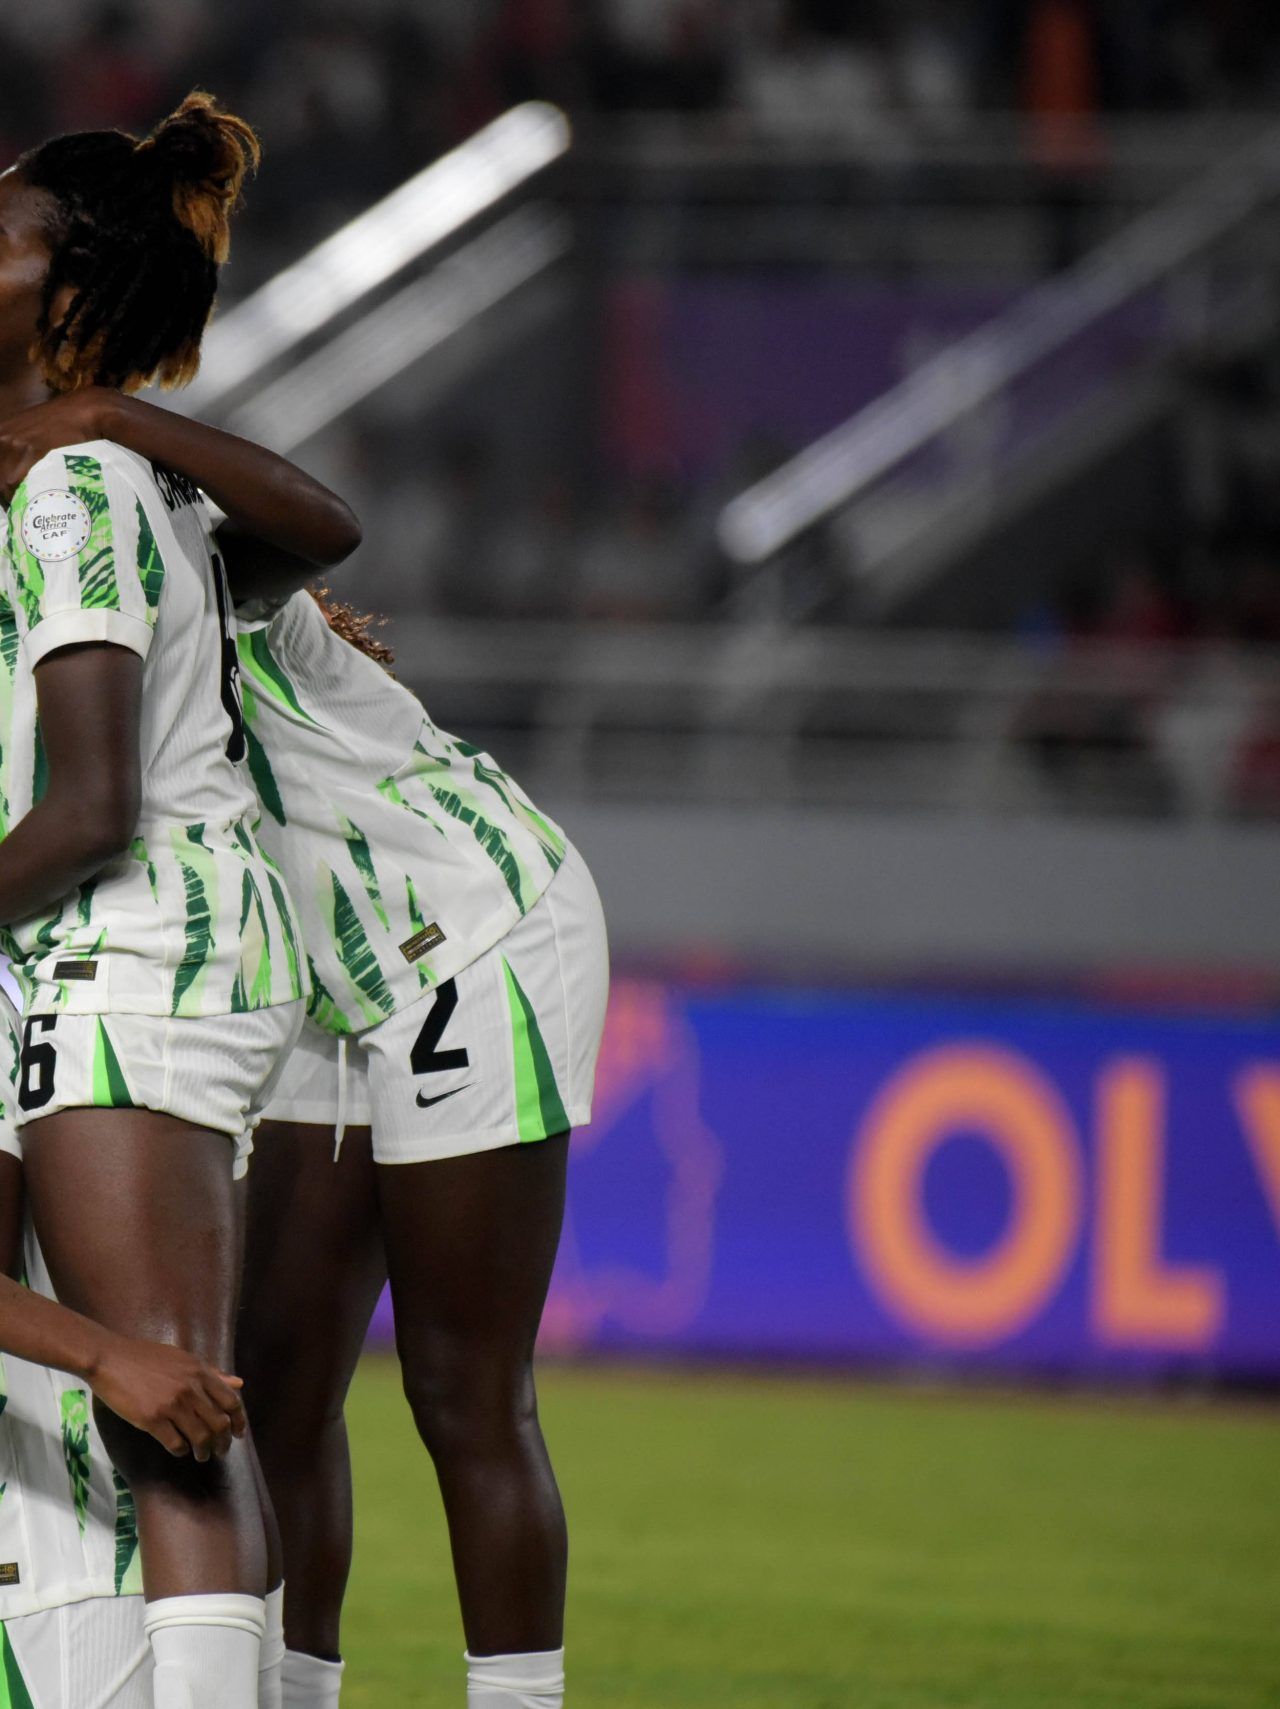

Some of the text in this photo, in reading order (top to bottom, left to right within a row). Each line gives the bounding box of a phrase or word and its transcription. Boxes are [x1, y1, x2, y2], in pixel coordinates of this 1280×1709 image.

[33, 513, 76, 529] Celebrate
[40, 521, 67, 533] Africa
[42, 529, 68, 540] CAF
[410, 976, 469, 1075] 2
[18, 1014, 57, 1112] 6
[850, 1040, 1280, 1352] OL
